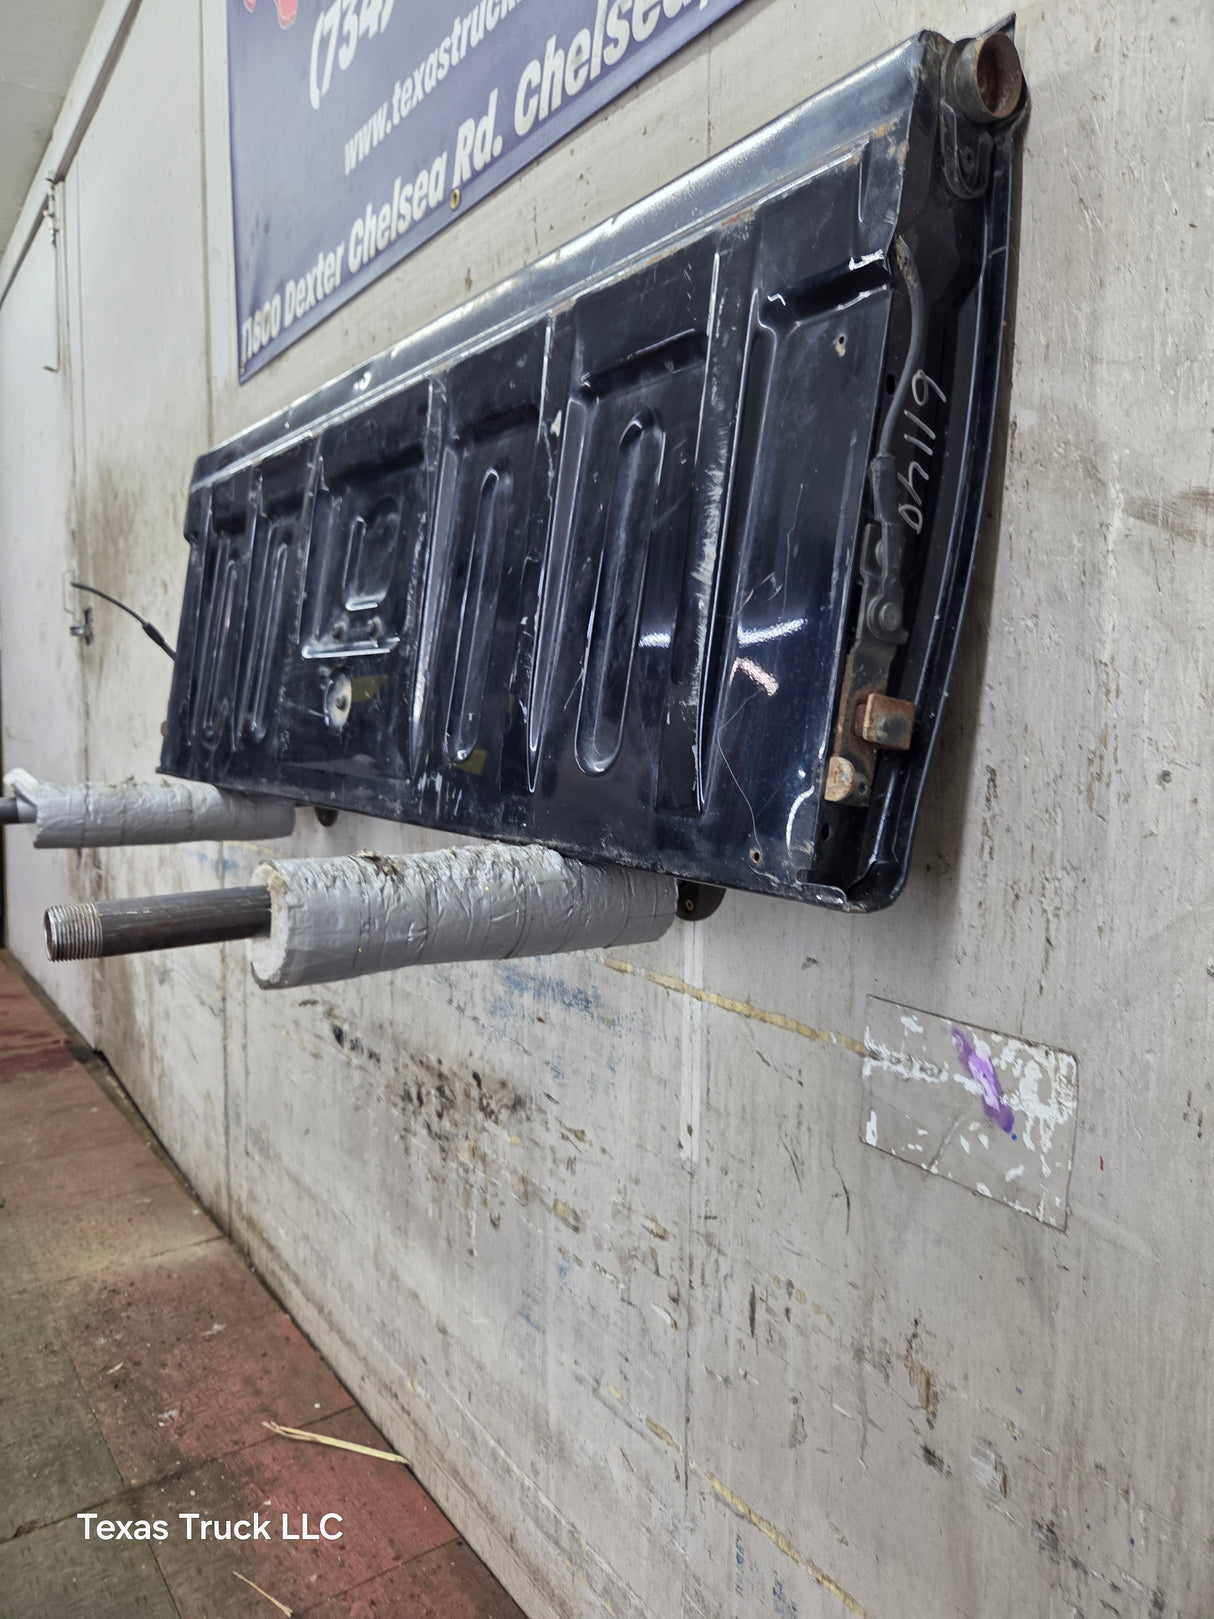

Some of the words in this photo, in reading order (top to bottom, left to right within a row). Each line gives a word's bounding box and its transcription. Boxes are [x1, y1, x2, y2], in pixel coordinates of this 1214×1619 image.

[283, 241, 345, 329] Dexter
[348, 150, 448, 273] Chelsea
[452, 87, 504, 189] Rd.
[513, 0, 709, 137] Chelse
[344, 0, 521, 175] www.texastruc
